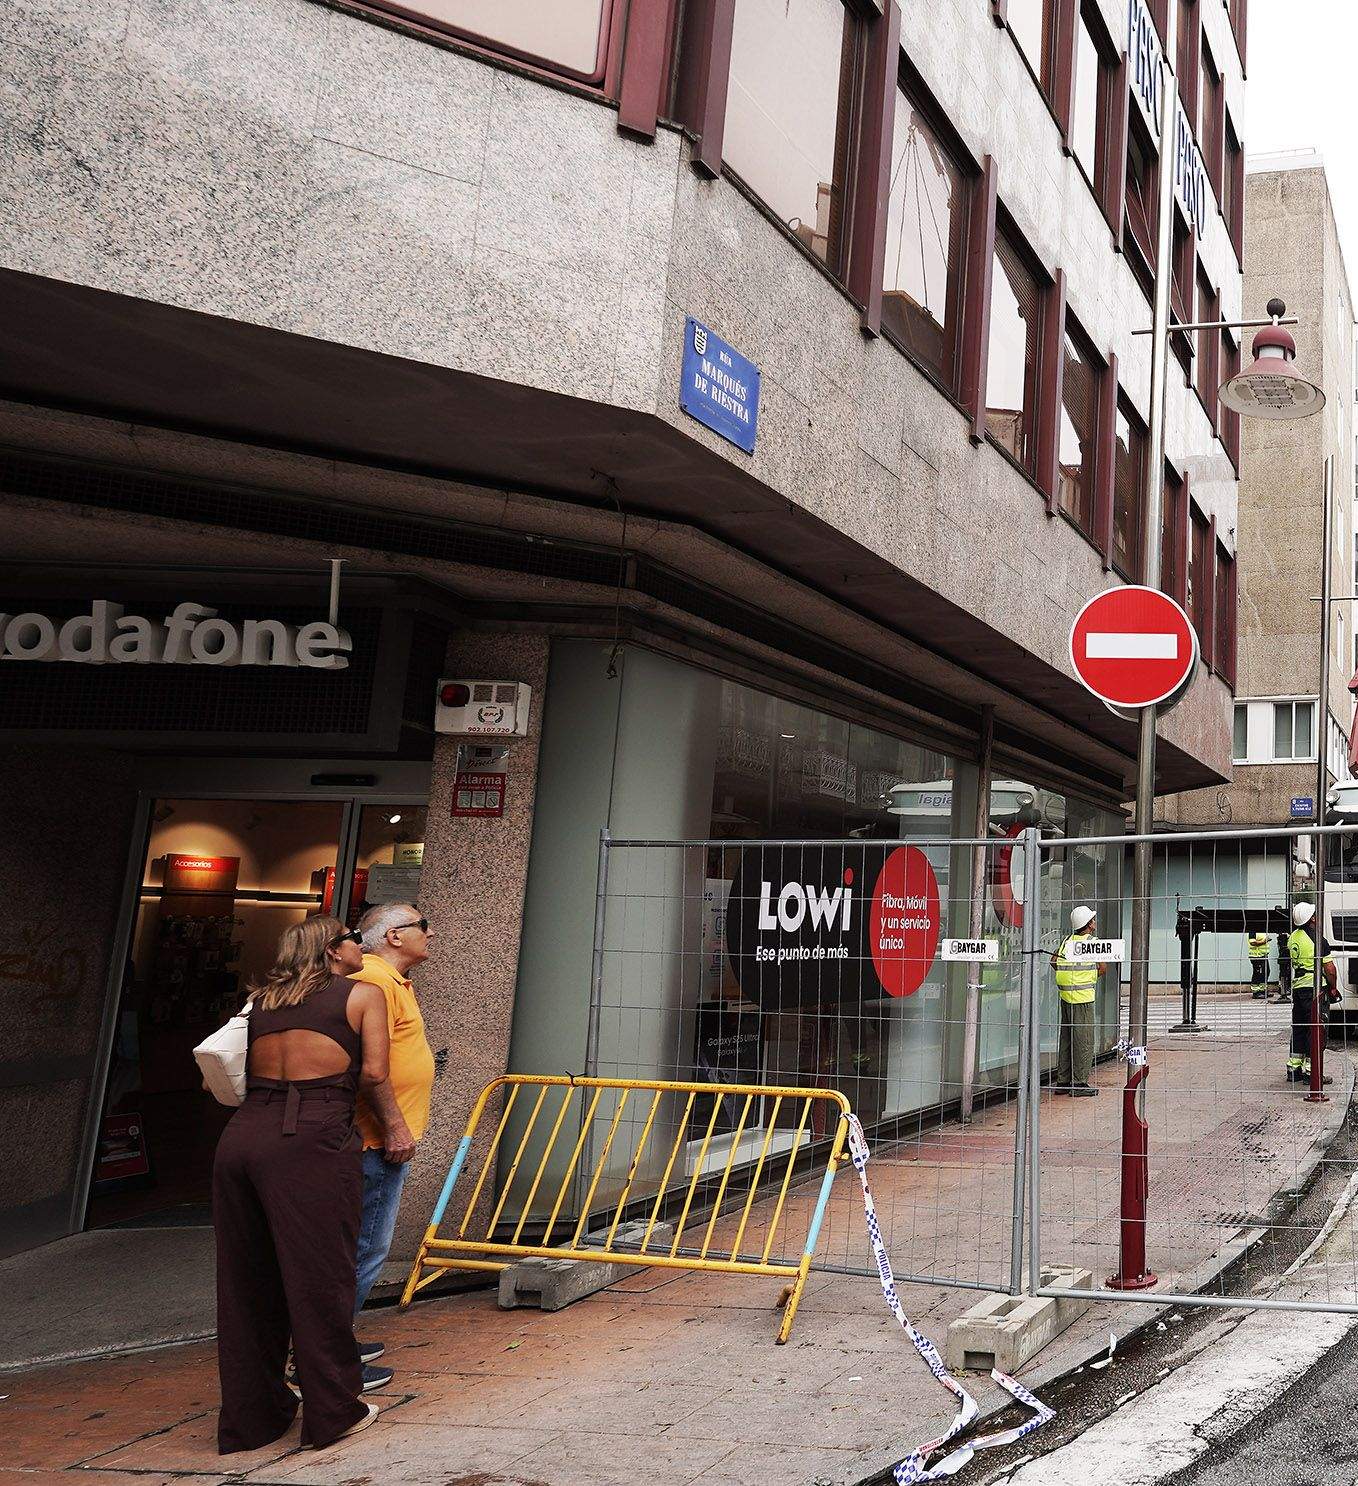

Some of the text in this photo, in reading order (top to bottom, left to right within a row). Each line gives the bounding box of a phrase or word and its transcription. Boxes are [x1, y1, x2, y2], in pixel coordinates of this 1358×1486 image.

[719, 350, 732, 367] RÚA
[701, 358, 747, 401] MARQUÉS
[694, 373, 708, 395] DE
[711, 384, 749, 424] RIESTRA
[0, 600, 352, 669] odafone
[459, 774, 502, 785] Alarma
[174, 859, 213, 869] Accesorios
[881, 893, 928, 910] Fibra, Móvil
[880, 916, 931, 934] y un servicio
[879, 935, 905, 951] único.
[756, 944, 849, 966] Ese punto de más
